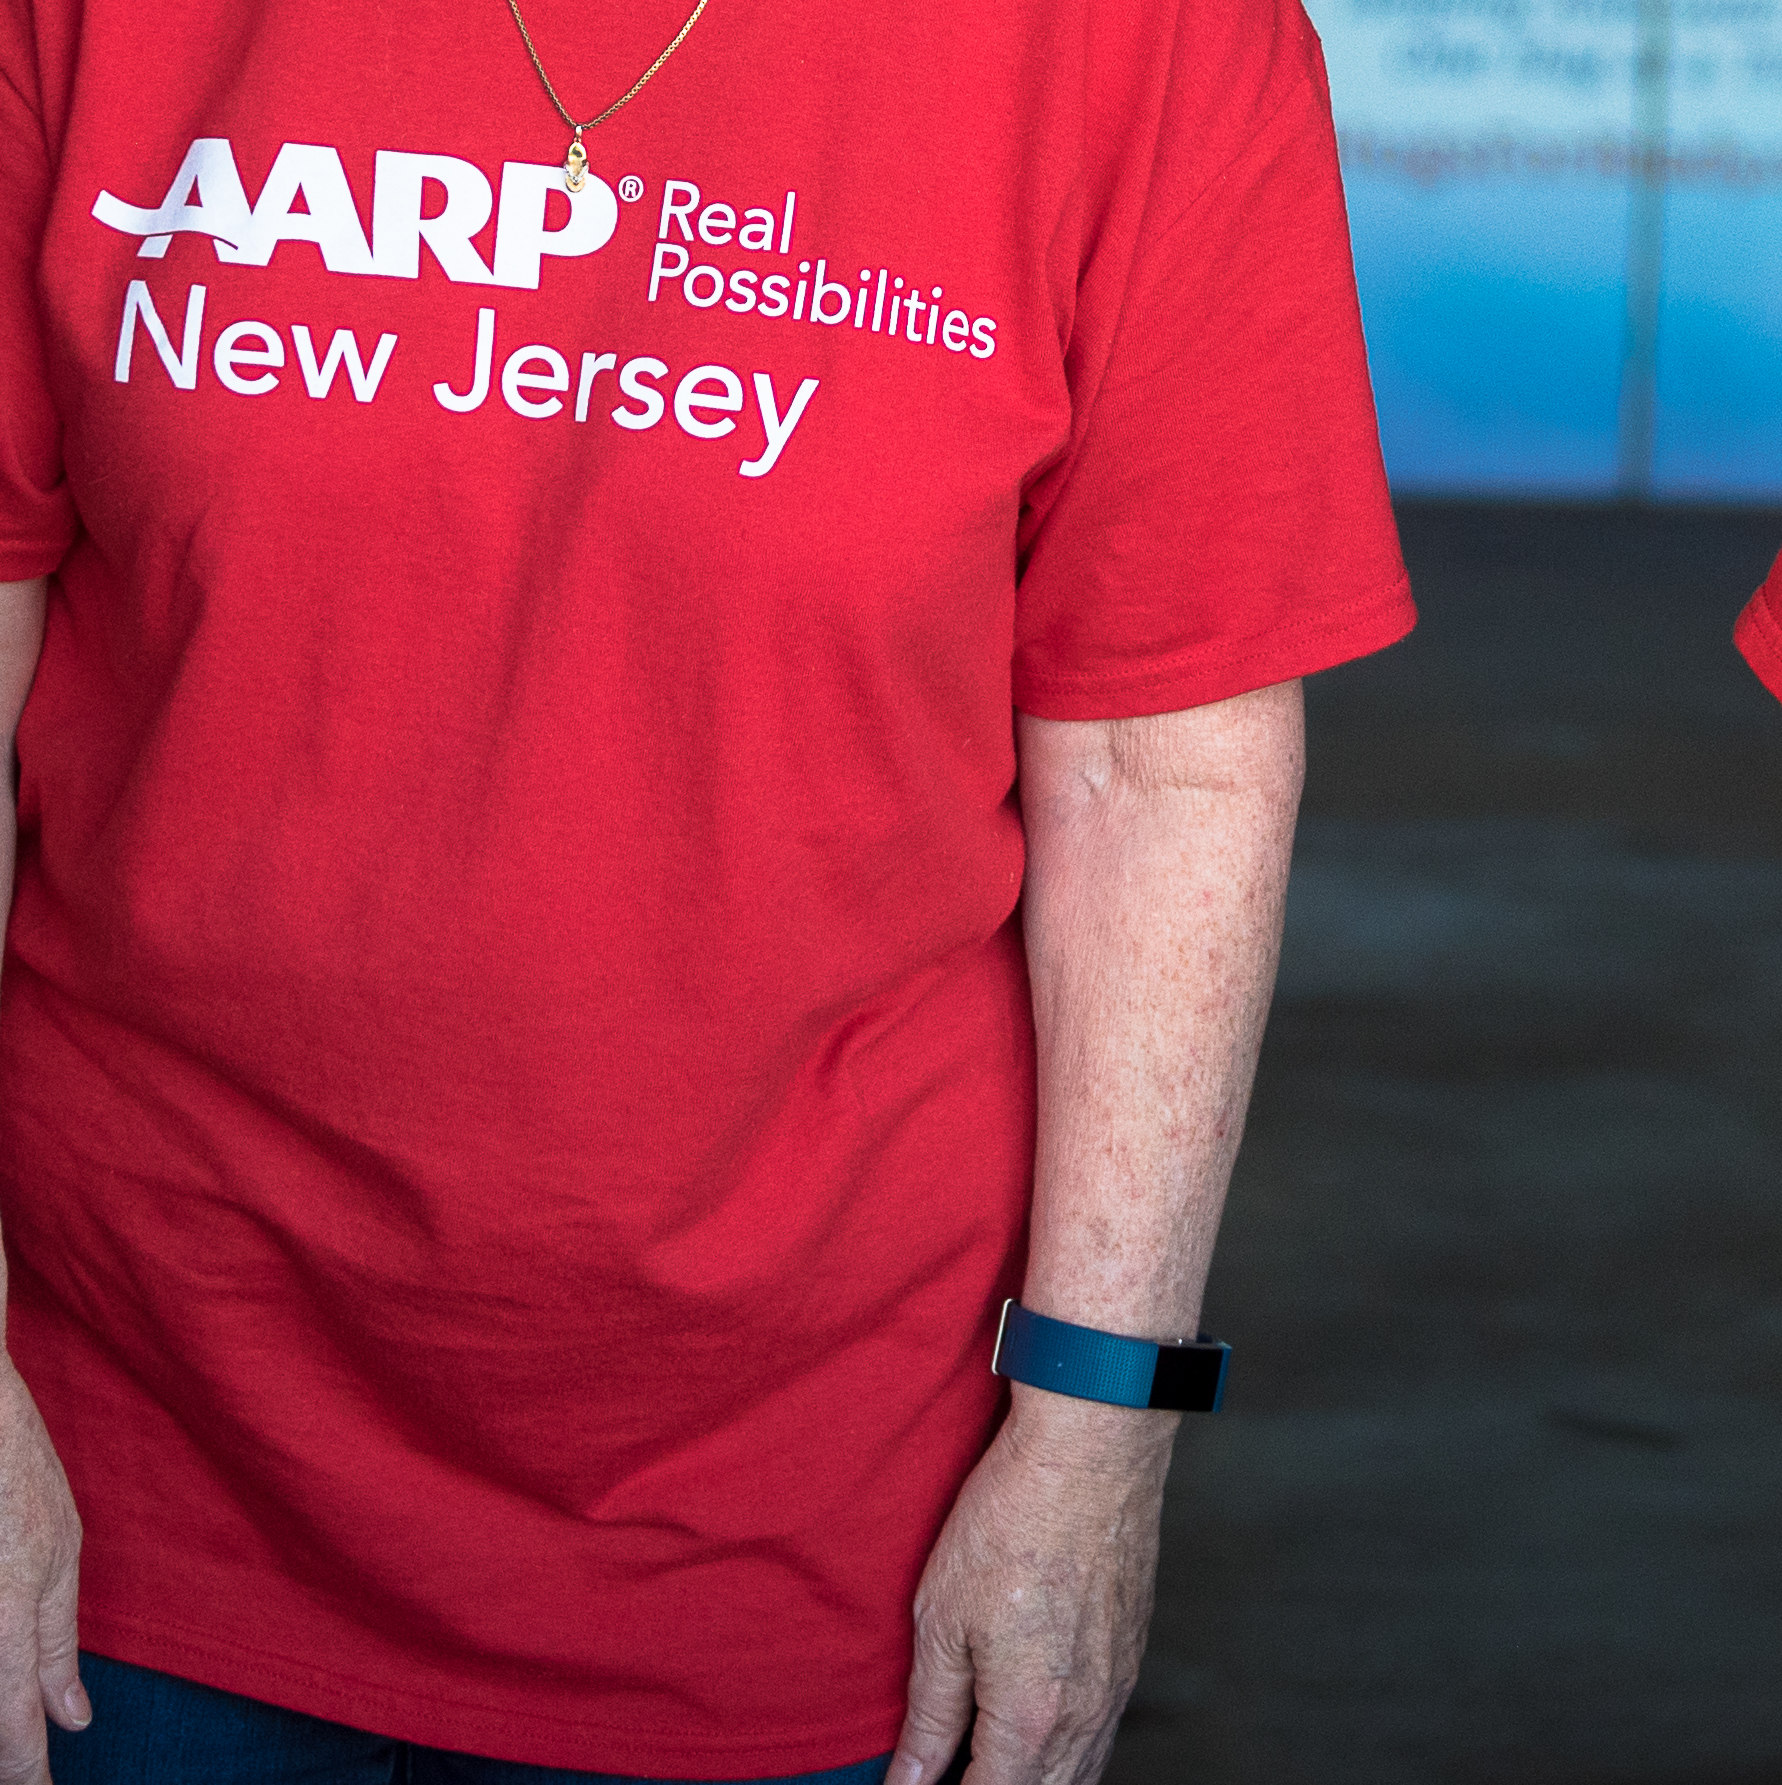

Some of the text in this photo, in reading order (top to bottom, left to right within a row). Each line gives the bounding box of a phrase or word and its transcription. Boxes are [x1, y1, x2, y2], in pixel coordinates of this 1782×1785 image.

[658, 179, 796, 254] Real
[647, 242, 998, 359] Possibilities
[114, 279, 820, 478] New Jersey
